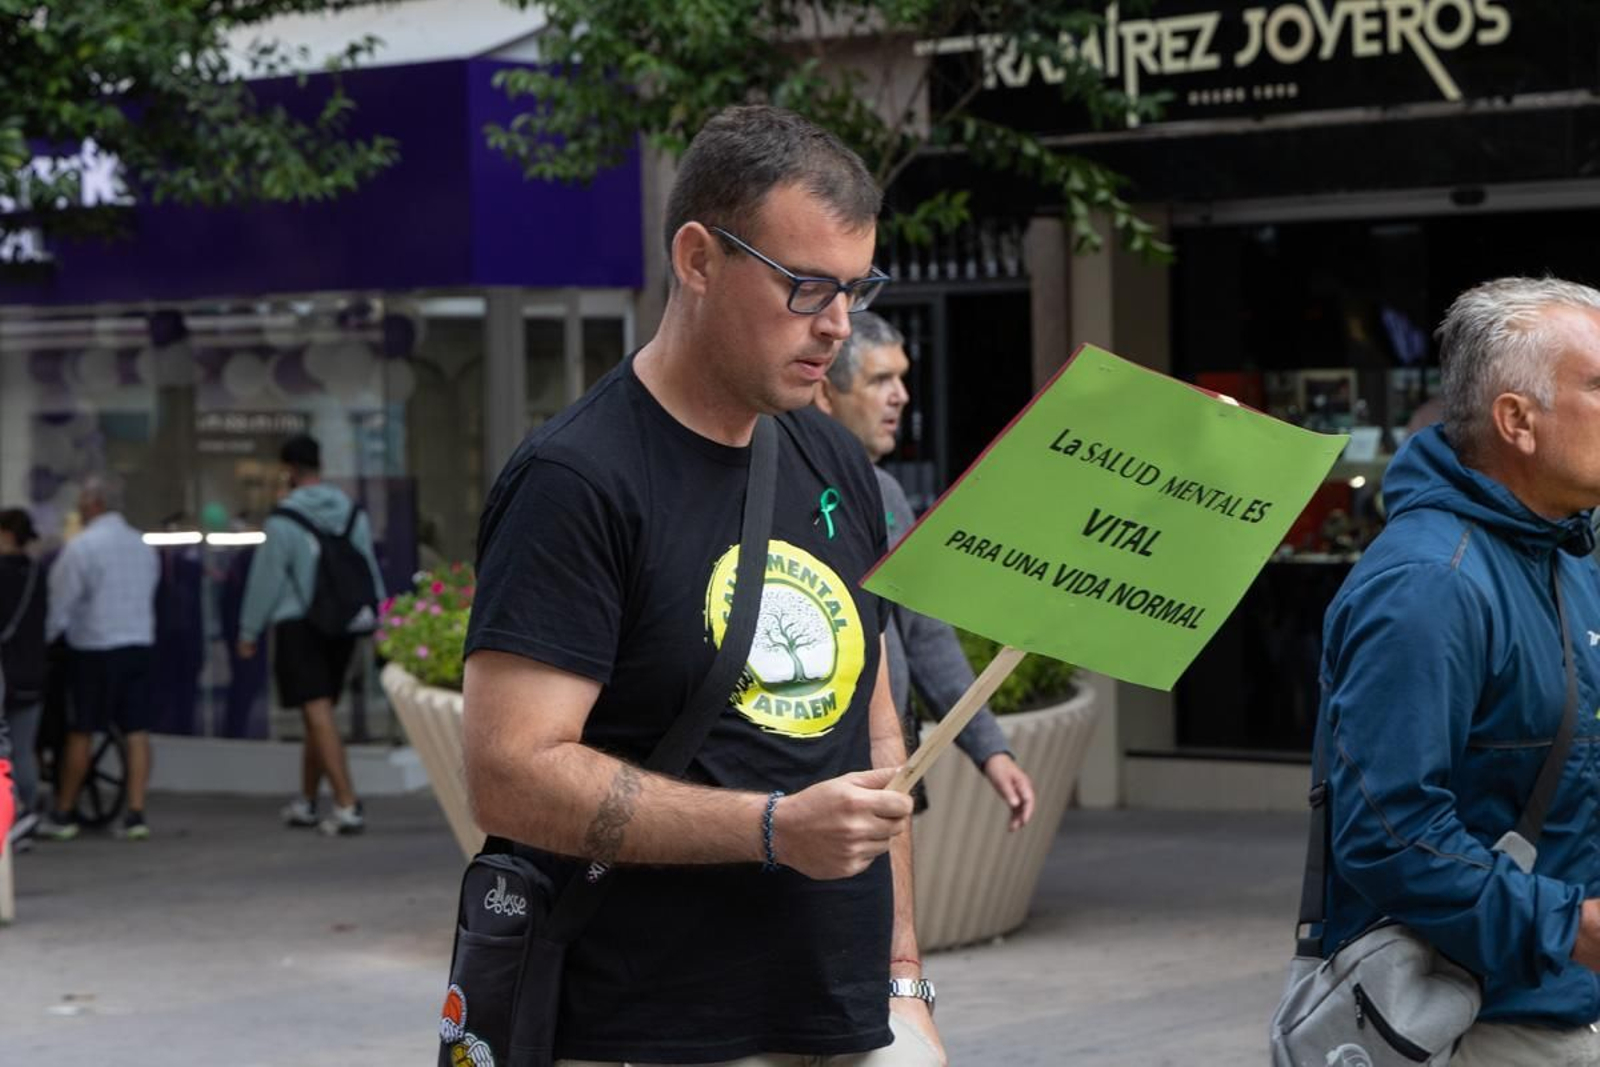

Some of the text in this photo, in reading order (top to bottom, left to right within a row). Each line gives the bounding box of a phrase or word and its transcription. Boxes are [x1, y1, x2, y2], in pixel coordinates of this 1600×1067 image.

[1234, 0, 1511, 100] JOYEROS
[1049, 428, 1273, 524] La SALUD MENTAL ES
[1081, 507, 1162, 557] VITAL
[766, 553, 848, 634] MENTAL
[944, 529, 1206, 630] PARA UNA VIDA NORMAL
[752, 691, 838, 721] APAEM
